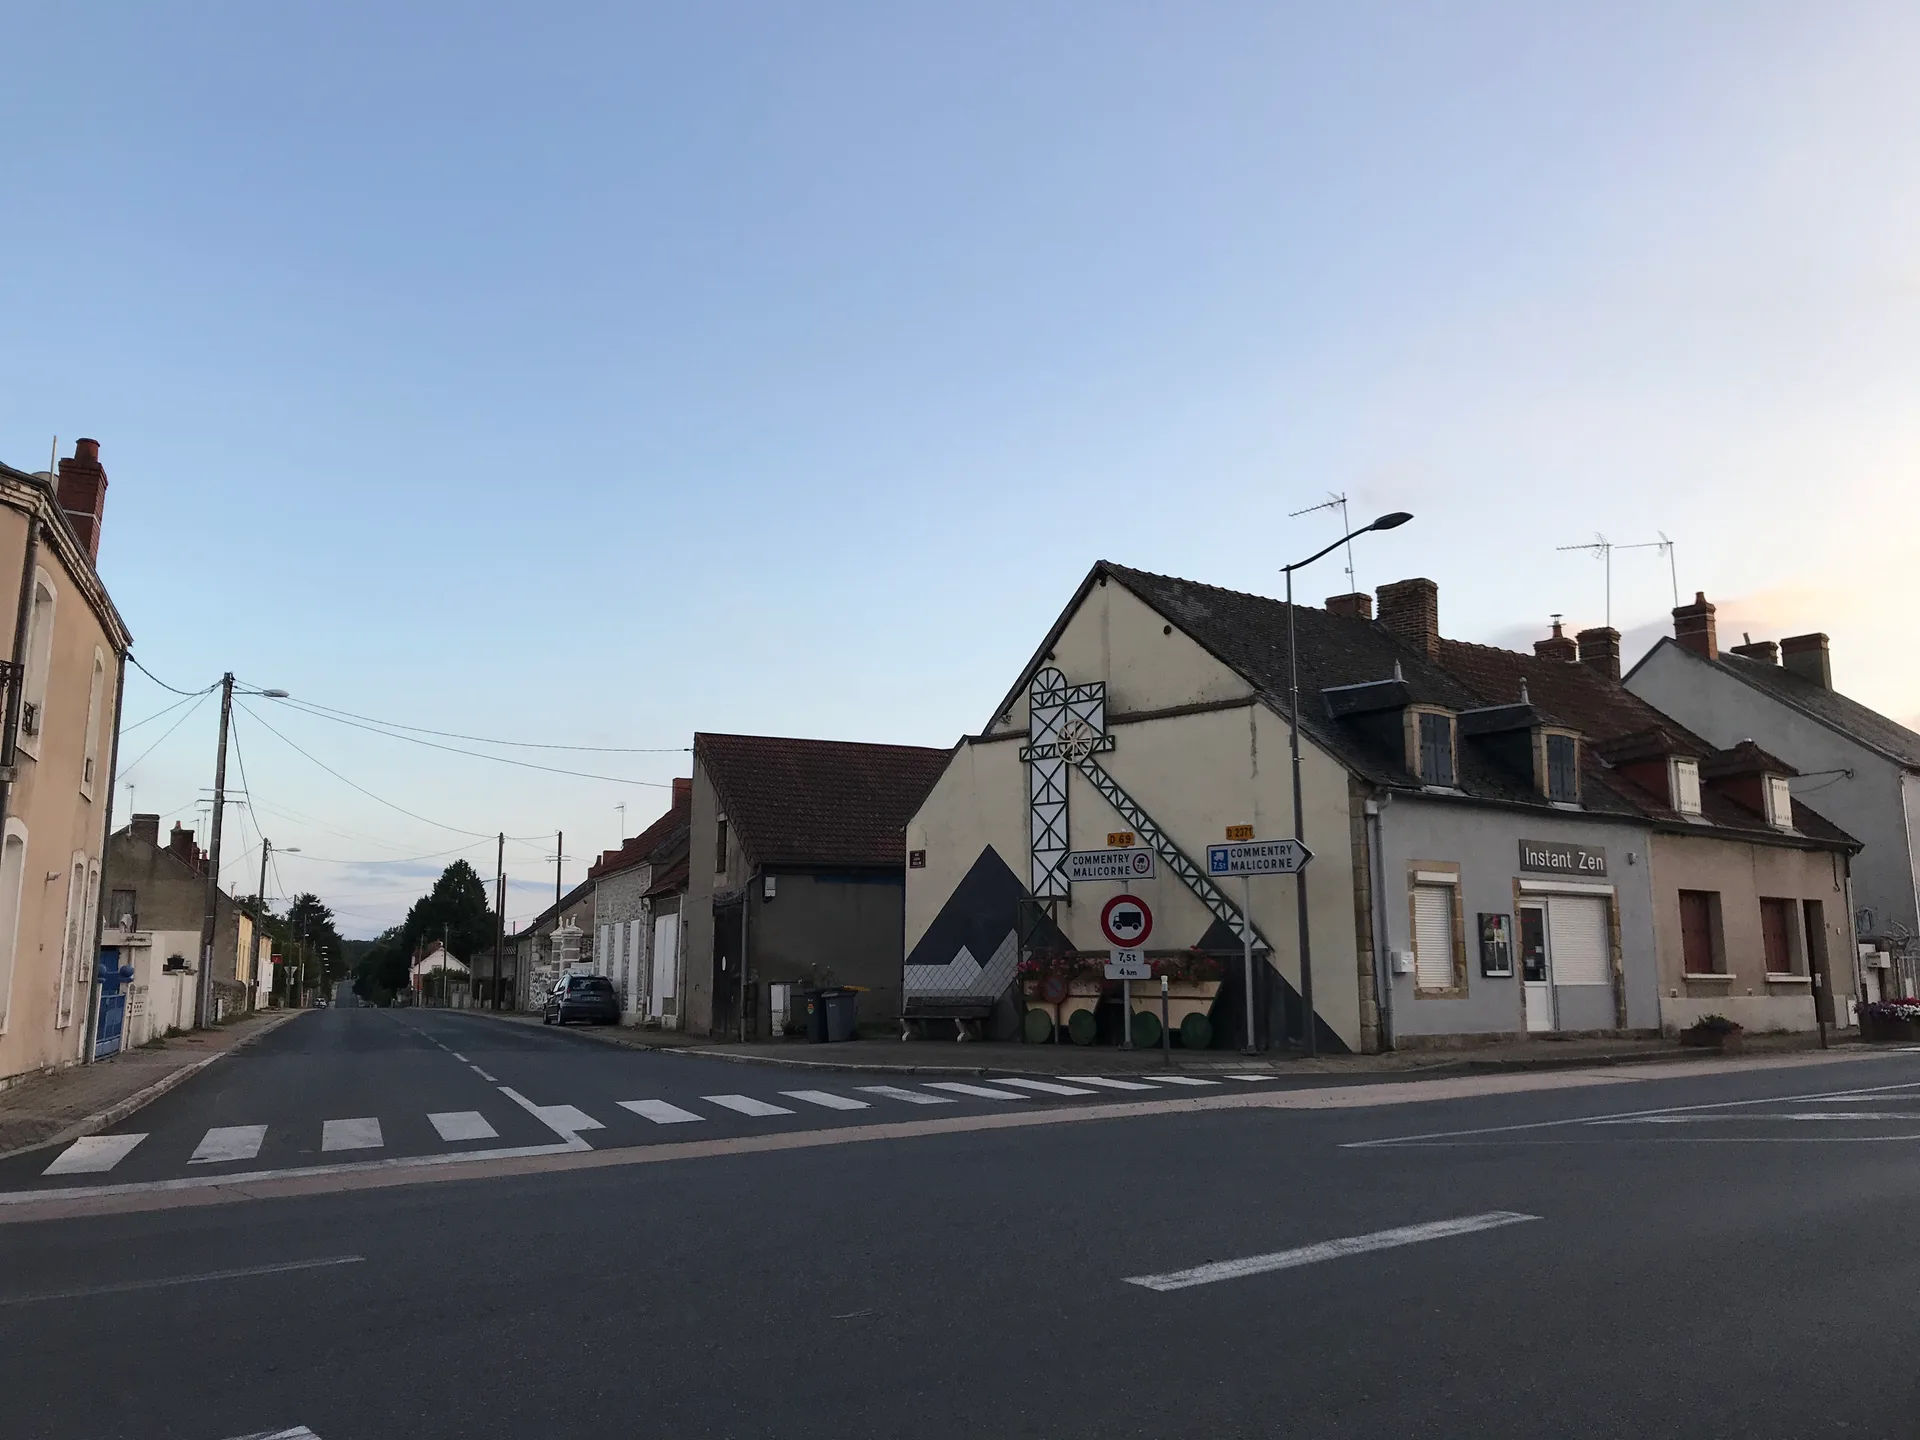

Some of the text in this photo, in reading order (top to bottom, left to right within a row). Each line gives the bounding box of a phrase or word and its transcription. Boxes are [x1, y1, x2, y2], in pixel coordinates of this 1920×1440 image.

[1109, 834, 1131, 844] D 69
[1227, 828, 1233, 838] D
[1230, 844, 1292, 858] COMMENTRY
[1072, 853, 1130, 866] COMMENTRY
[1231, 858, 1292, 871] MALICORNE
[1525, 847, 1604, 870] Instant Zen
[1073, 865, 1131, 877] MALICORNE
[1119, 967, 1125, 976] 4
